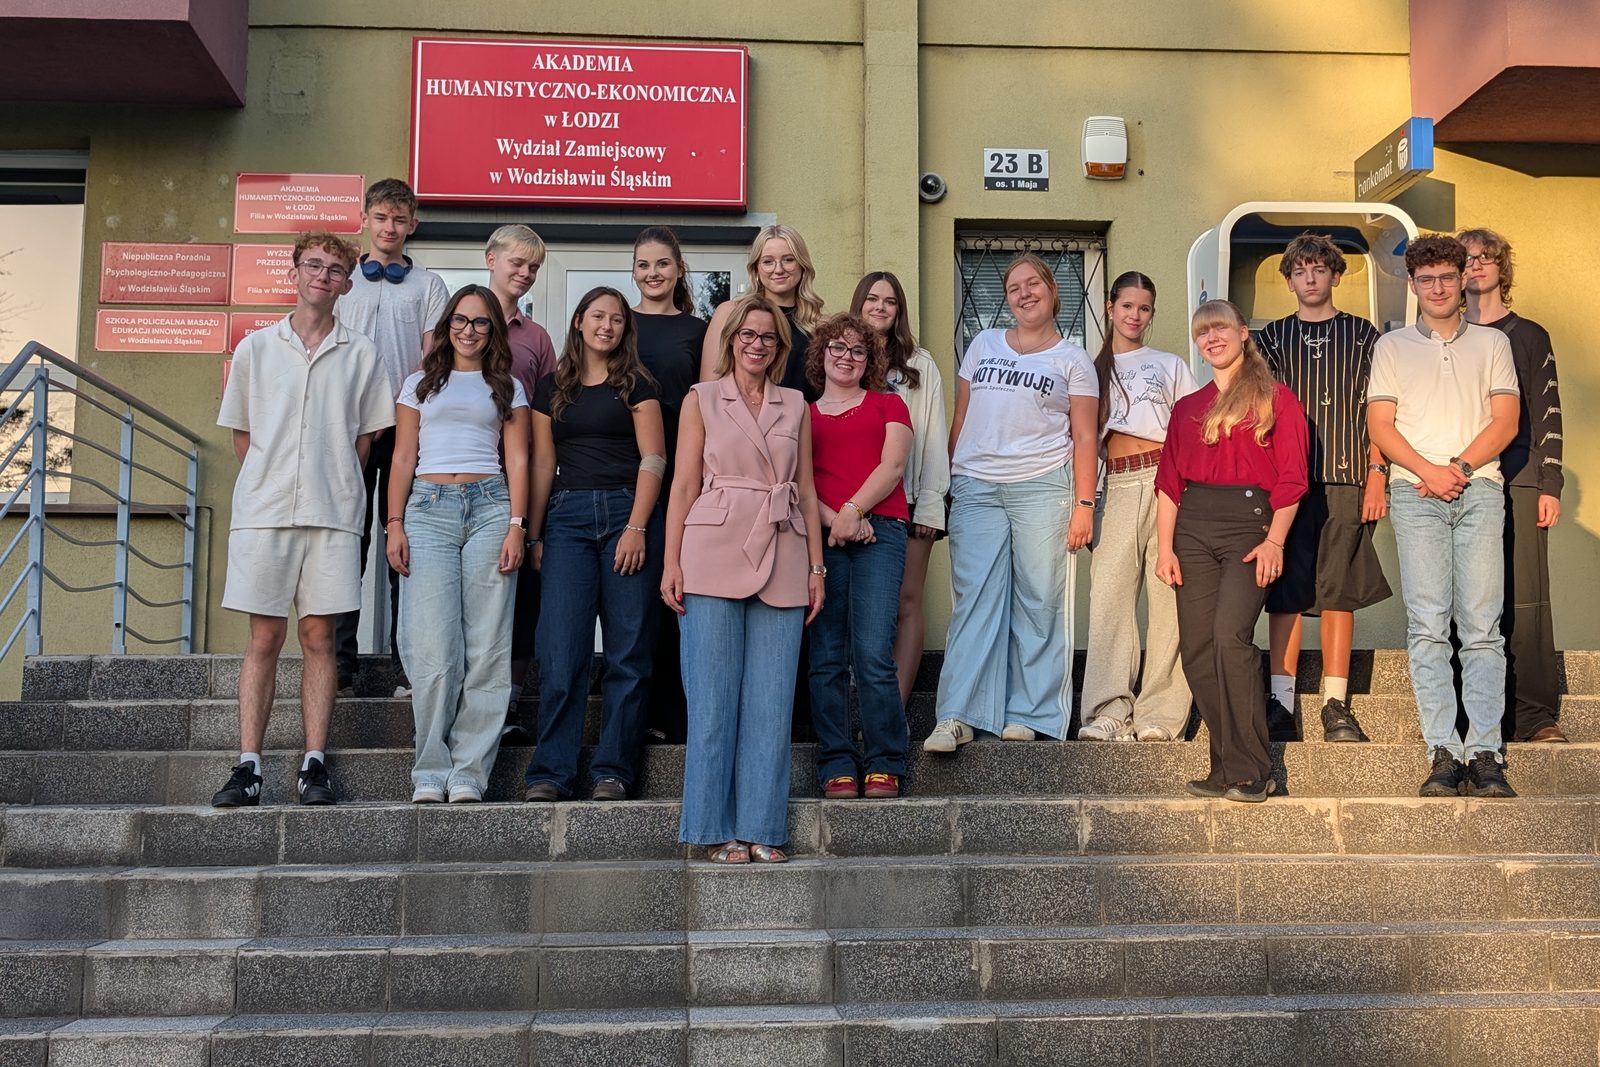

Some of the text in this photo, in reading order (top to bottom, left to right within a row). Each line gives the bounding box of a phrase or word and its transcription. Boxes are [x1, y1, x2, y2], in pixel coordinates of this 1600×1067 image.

[532, 53, 634, 72] AKADEMIA
[426, 79, 737, 103] HUMANISTYCZNO-EKONOMICZNA
[544, 111, 619, 129] w ŁODZI
[496, 138, 667, 162] Wydział Zamiejscowy
[990, 152, 1043, 174] 23 B
[489, 166, 672, 191] w Wodzisławiu Śląskim
[280, 185, 320, 193] AKADEMIA
[995, 180, 1038, 190] os. 1 Maja
[239, 194, 360, 203] HUMANISTYCZNO-EKONOMICZNA
[320, 212, 347, 222] Śląskim
[122, 252, 211, 262] Niepubliczna Poradnia
[105, 268, 226, 278] Psychologiczno-Pedagogiczna
[128, 285, 177, 293] Wodzisławiu
[180, 283, 211, 295] Śląskim
[138, 318, 186, 326] POLICEALNA
[187, 318, 219, 327] MASAŻU
[151, 328, 211, 336] INNOWACYJNEJ
[174, 337, 202, 346] Śląskim
[972, 366, 1055, 398] MOTYWUJĘ!
